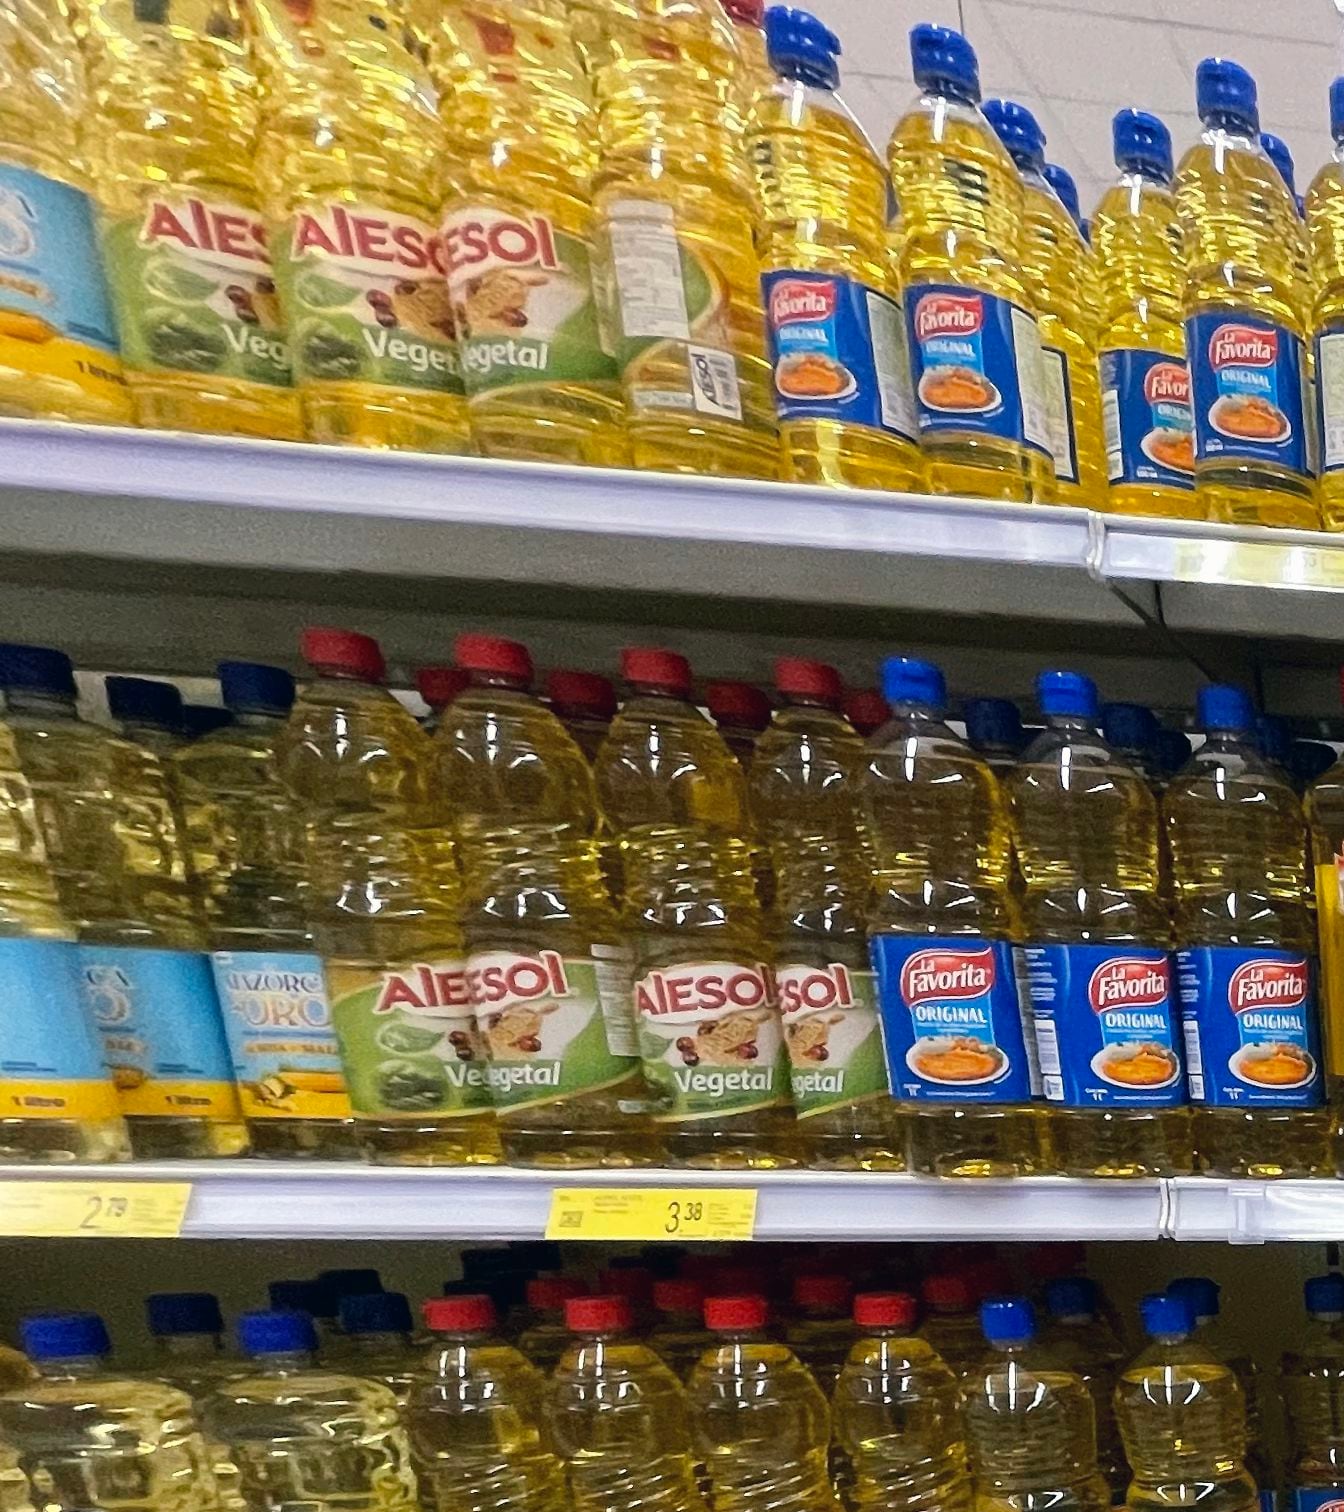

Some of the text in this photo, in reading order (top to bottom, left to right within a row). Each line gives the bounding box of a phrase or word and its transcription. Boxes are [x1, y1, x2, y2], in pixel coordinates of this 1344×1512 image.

[920, 306, 975, 334] Favorita
[1215, 339, 1272, 364] Favorita
[909, 963, 986, 998] Favorita
[1099, 969, 1166, 1005] Favorita
[1238, 970, 1303, 1005] Favorita
[915, 1005, 987, 1024] ORIGINAL
[1105, 1012, 1167, 1029] ORIGINAL
[1243, 1013, 1303, 1029] ORIGINAL
[674, 1066, 772, 1097] Vegetal
